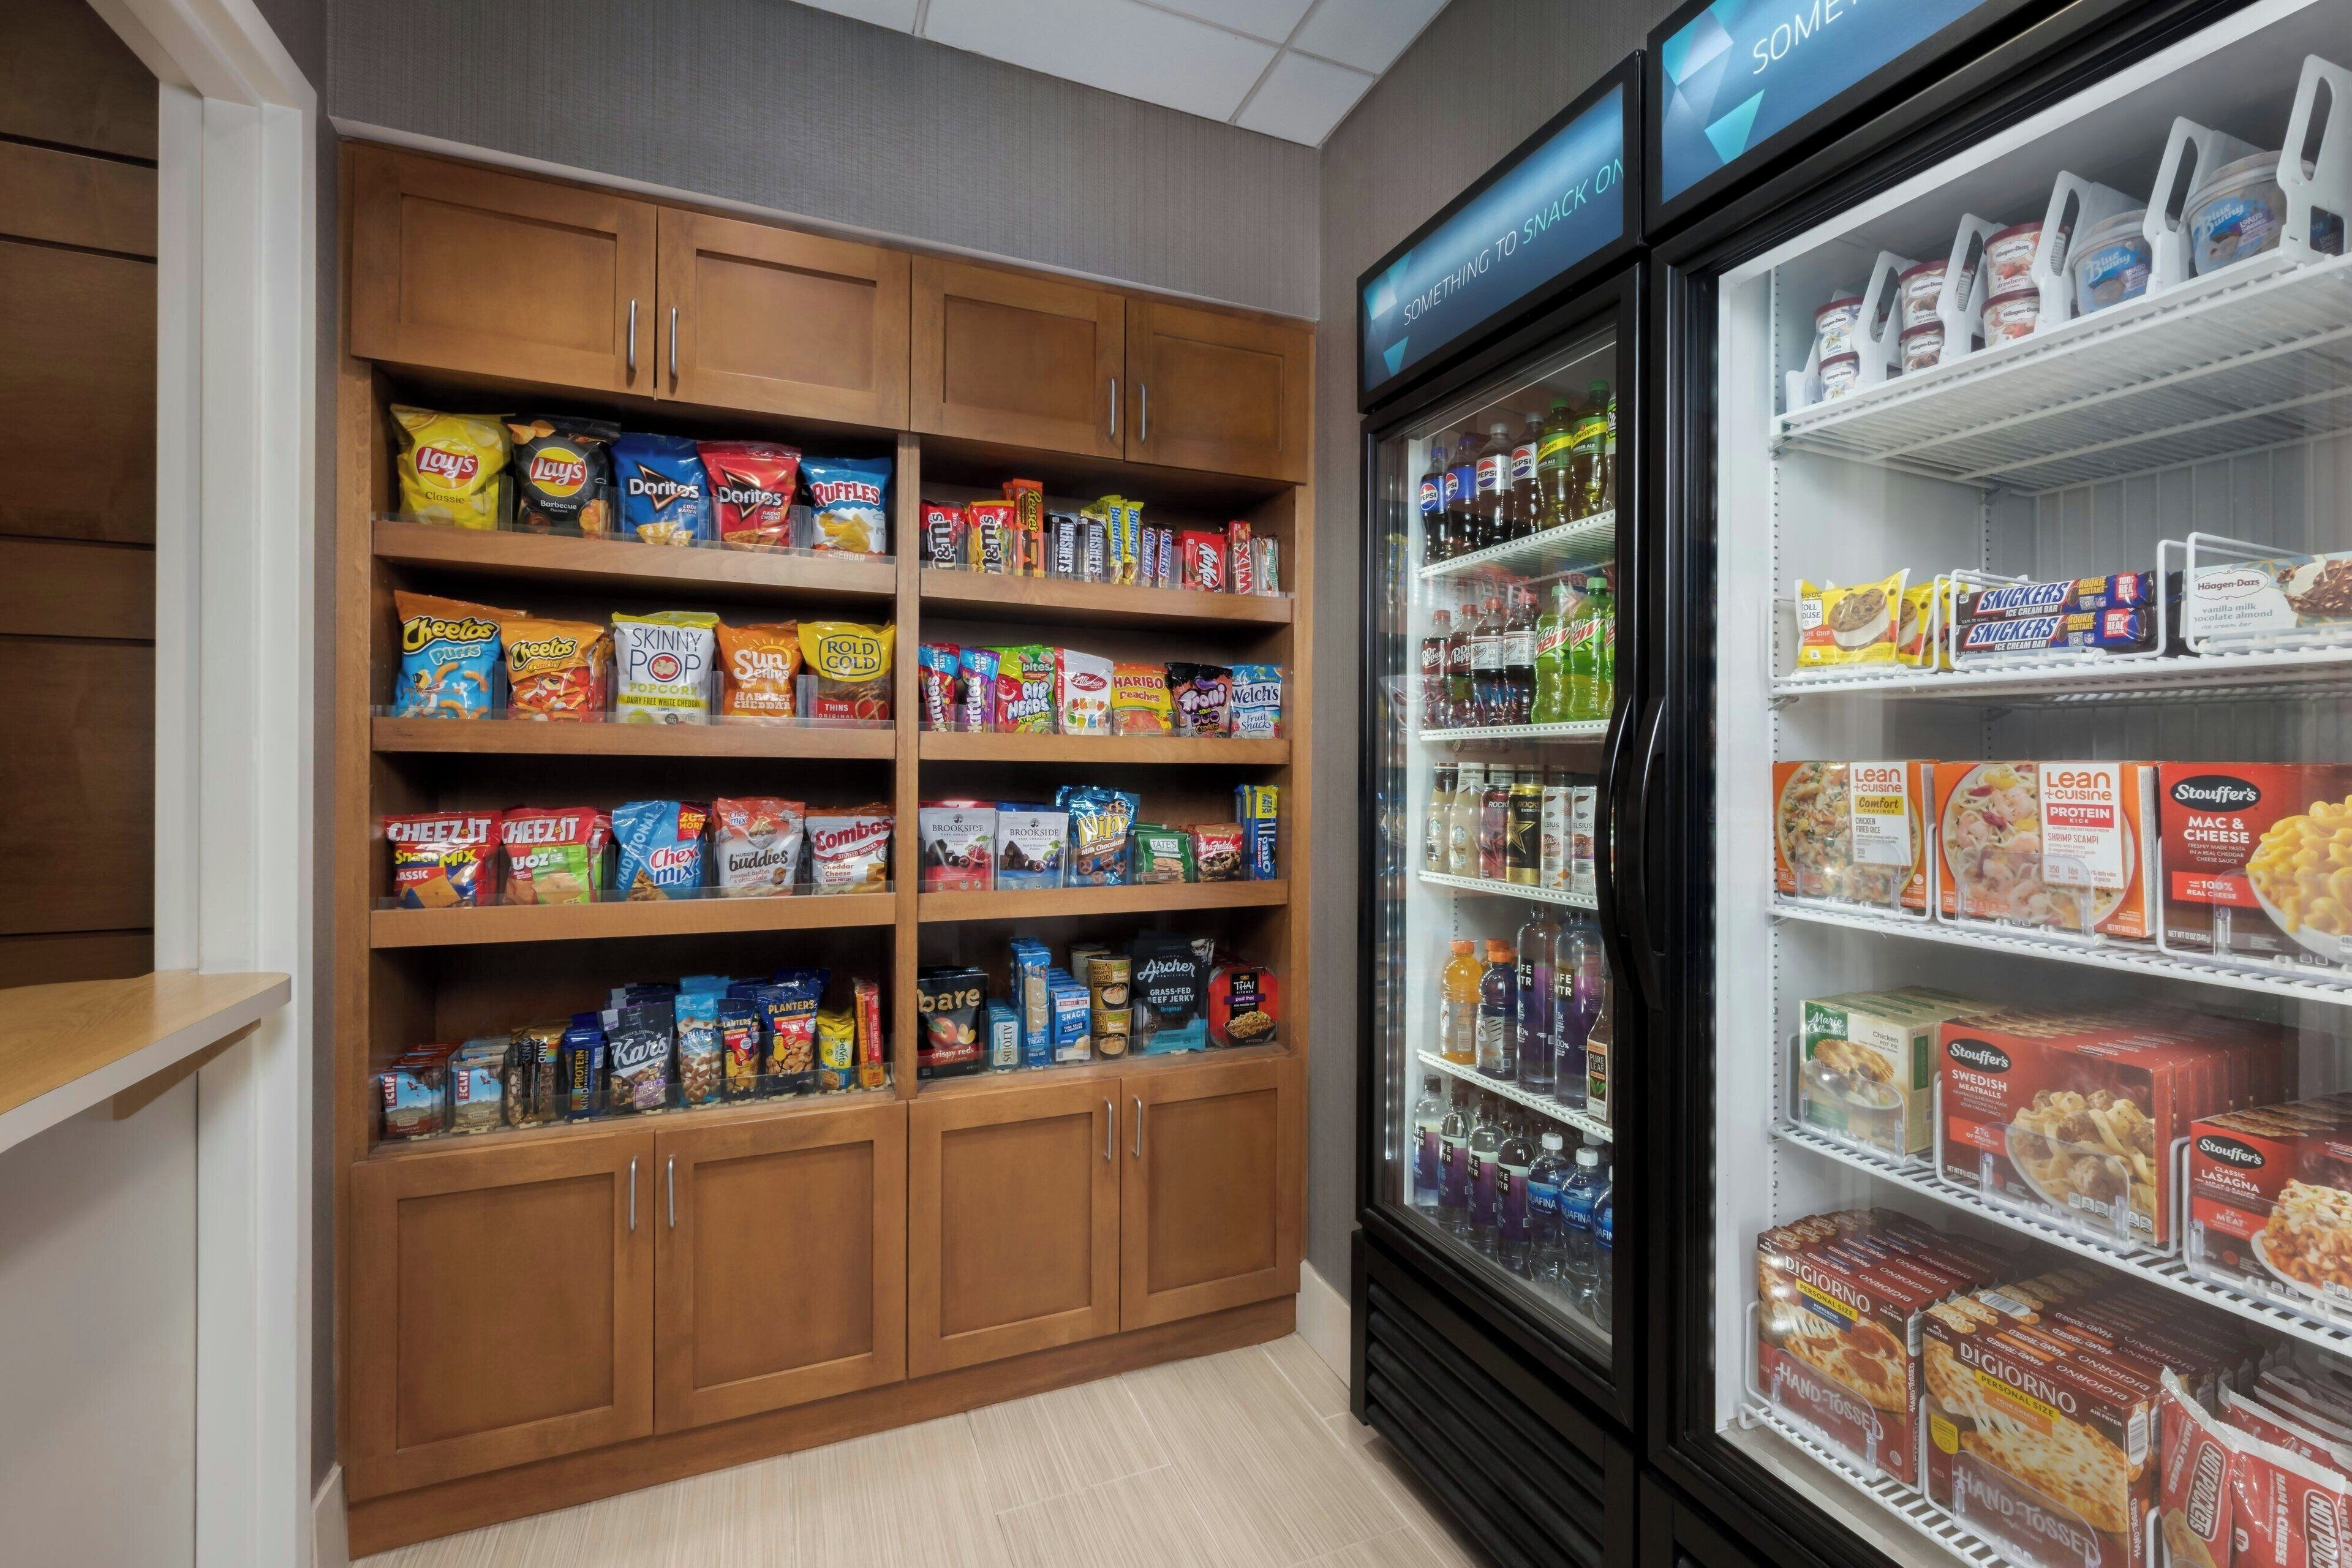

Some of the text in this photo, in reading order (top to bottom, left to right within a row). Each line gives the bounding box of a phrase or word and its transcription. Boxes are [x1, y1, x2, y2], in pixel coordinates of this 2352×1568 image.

[1754, 0, 1856, 74] SOME
[1404, 249, 1489, 326] SOMETHING
[1496, 231, 1517, 262] TO
[1523, 178, 1588, 244] SNACK
[1997, 276, 2028, 290] strawberry
[419, 447, 477, 478] Lay's
[533, 456, 584, 485] Lay's
[1512, 458, 1532, 469] PEPSI
[1477, 470, 1497, 479] PEPSI
[630, 478, 699, 499] Doritos
[718, 486, 782, 506] Doritos
[811, 481, 881, 507] RUFFLES
[426, 491, 464, 504] Classic
[540, 500, 577, 510] Barbecue
[827, 549, 865, 563] CHEDDAR
[1144, 531, 1155, 576] SNICKERS
[2198, 579, 2260, 591] Häagen-Dazs
[1980, 581, 2068, 611] SNICKERS
[2203, 603, 2256, 614] vanilla milk
[2067, 623, 2095, 631] MISTAKE
[2068, 614, 2095, 624] ROOKIE
[403, 616, 499, 654] Cheetos
[1970, 617, 2057, 644] SNICKERS
[508, 636, 577, 671] Cheetos
[827, 640, 873, 654] ROLD
[1994, 643, 2007, 651] ICE
[2008, 641, 2030, 650] CREAM
[630, 649, 701, 682] POP
[826, 655, 875, 669] GOLD
[1022, 663, 1050, 672] bites
[629, 683, 698, 695] POPCORN
[1022, 682, 1050, 699] AIR
[1114, 676, 1164, 689] HARIBO
[627, 696, 700, 708] DAIRY FREE WHITE CHEDDAR
[735, 692, 791, 701] HARVEST
[1120, 691, 1160, 701] Peaches
[1180, 684, 1226, 712] Trolli
[1232, 686, 1278, 703] Welch's
[734, 701, 791, 710] CHEDDAR
[1007, 697, 1050, 719] HEADS
[1191, 711, 1219, 726] DUO
[1247, 714, 1266, 723] Fruit
[1196, 723, 1219, 734] Crawlers
[2176, 784, 2256, 803] Stouffer's
[1859, 797, 1899, 809] Comfort
[2050, 807, 2109, 819] PROTEIN
[2188, 816, 2244, 829] MAC &
[816, 818, 891, 851] Combos
[2048, 832, 2099, 845] SHRIMP SCAMPI
[2184, 829, 2250, 844] CHEESE
[619, 810, 659, 890] TRADITIONAL
[838, 842, 878, 861] STUFFED SNACKS
[1096, 839, 1125, 851] Chocolate
[650, 845, 699, 868] Chex
[729, 848, 788, 872] buddies
[1262, 836, 1271, 873] OREO
[654, 859, 699, 886] mix
[2201, 881, 2233, 891] 100%
[2187, 889, 2237, 900] REAL CHEESE
[1137, 959, 1195, 982] Archer
[1150, 987, 1191, 996] GRASS-FED
[1234, 981, 1254, 990] THAI
[917, 989, 979, 1012] bare
[1169, 994, 1194, 1003] JERKY
[769, 1000, 814, 1014] PLANTERS
[1061, 1010, 1085, 1021] SNACK
[1808, 1012, 1844, 1028] Marie
[1807, 1023, 1848, 1036] Callender's
[1873, 1031, 1899, 1043] Chicken
[538, 1039, 547, 1063] KIND
[1003, 1025, 1012, 1062] ALTOIDS
[932, 1046, 974, 1059] crispy reds
[1590, 1054, 1604, 1063] PURE
[1950, 1043, 2008, 1068] Stouffer's
[575, 1050, 585, 1088] PROTEIN
[1590, 1061, 1604, 1072] LEAF
[385, 1075, 395, 1100] CLIF
[1952, 1069, 2007, 1092] SWEDISH
[1958, 1083, 2002, 1099] MEATBALLS
[2199, 1139, 2262, 1166] Stouffer's
[2215, 1166, 2245, 1179] CLASSIC
[2201, 1169, 2260, 1193] LASAGNA
[1800, 1284, 1853, 1317] PERSONAL SIZE
[1776, 1362, 1884, 1441] HAND-TOSSED
[1981, 1375, 2054, 1418] PERSONAL SIZE
[2188, 1446, 2222, 1536] HOT POCKETS
[2276, 1472, 2288, 1504] HAM
[1952, 1464, 2101, 1567] HAND-TOSSED
[2275, 1517, 2288, 1566] CHEESE
